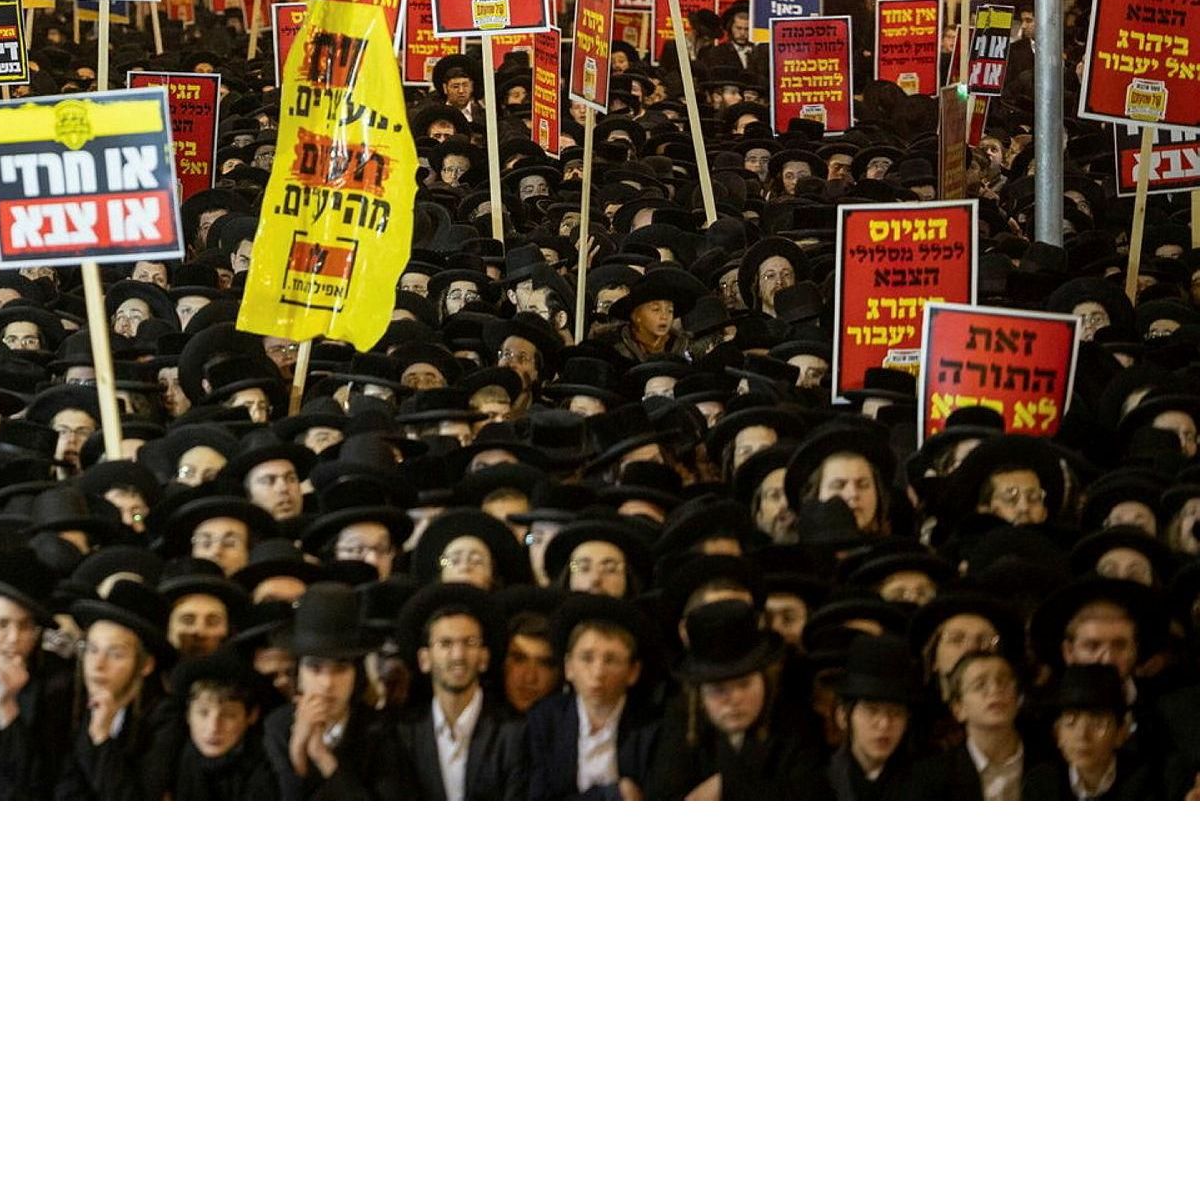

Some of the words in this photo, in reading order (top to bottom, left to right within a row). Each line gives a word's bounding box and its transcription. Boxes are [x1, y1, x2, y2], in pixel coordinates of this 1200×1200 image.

[771, 1, 802, 15] כאן!
[881, 8, 913, 24] אחד
[915, 8, 936, 25] אין
[1126, 3, 1188, 26] הצבא
[781, 25, 837, 39] הסכמה
[1116, 28, 1190, 57] ביהרג
[777, 41, 811, 54] הגיוס
[815, 40, 844, 53] לחוק
[783, 58, 839, 72] הסכמה
[1098, 50, 1159, 75] יעבור
[780, 73, 843, 88] להחרבת
[782, 89, 843, 104] היהדות
[0, 150, 98, 198] חרדי
[104, 145, 159, 192] או
[181, 158, 208, 175] ואל
[10, 200, 99, 249] צבא
[107, 197, 161, 242] או
[869, 218, 947, 242] הגיוס
[850, 244, 913, 263] מסלולי
[919, 242, 964, 260] לכלל
[874, 266, 939, 287] הצבא
[847, 325, 915, 346] יעבור
[965, 323, 1037, 356] זאת
[938, 357, 1057, 392] התורה
[1012, 398, 1057, 429] לא
